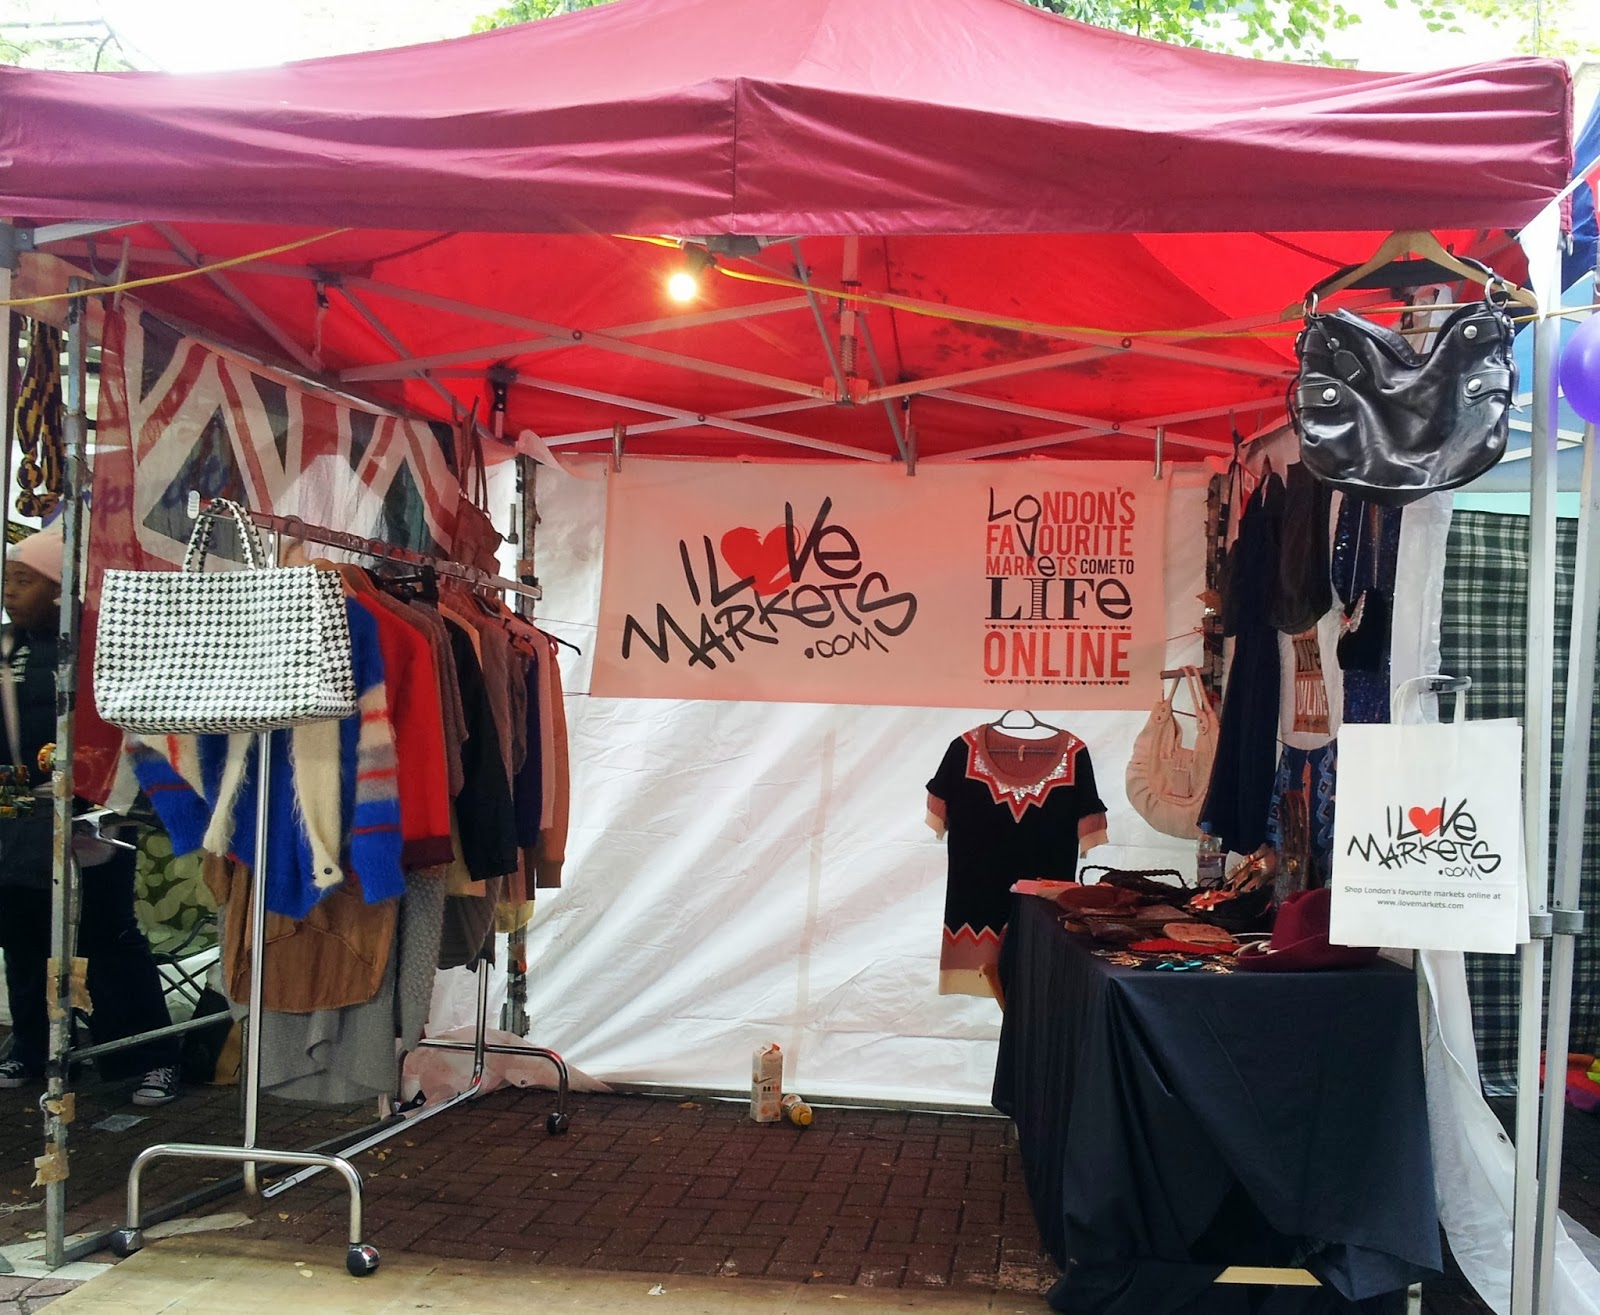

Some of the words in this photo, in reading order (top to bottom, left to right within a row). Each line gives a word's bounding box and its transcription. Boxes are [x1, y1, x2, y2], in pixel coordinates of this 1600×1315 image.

[987, 486, 1137, 525] LONDON'S
[985, 521, 1135, 557] FAVOURITE
[1079, 558, 1117, 575] COME
[1119, 558, 1135, 575] TO
[983, 630, 1133, 679] ONLINE
[1344, 885, 1363, 895] Shop
[1364, 886, 1397, 896] London's
[1398, 888, 1433, 897] favourite
[1433, 890, 1466, 899] markets
[1466, 891, 1492, 900] online
[1492, 892, 1502, 900] at
[1376, 899, 1465, 910] www.ilovemarkets.com
